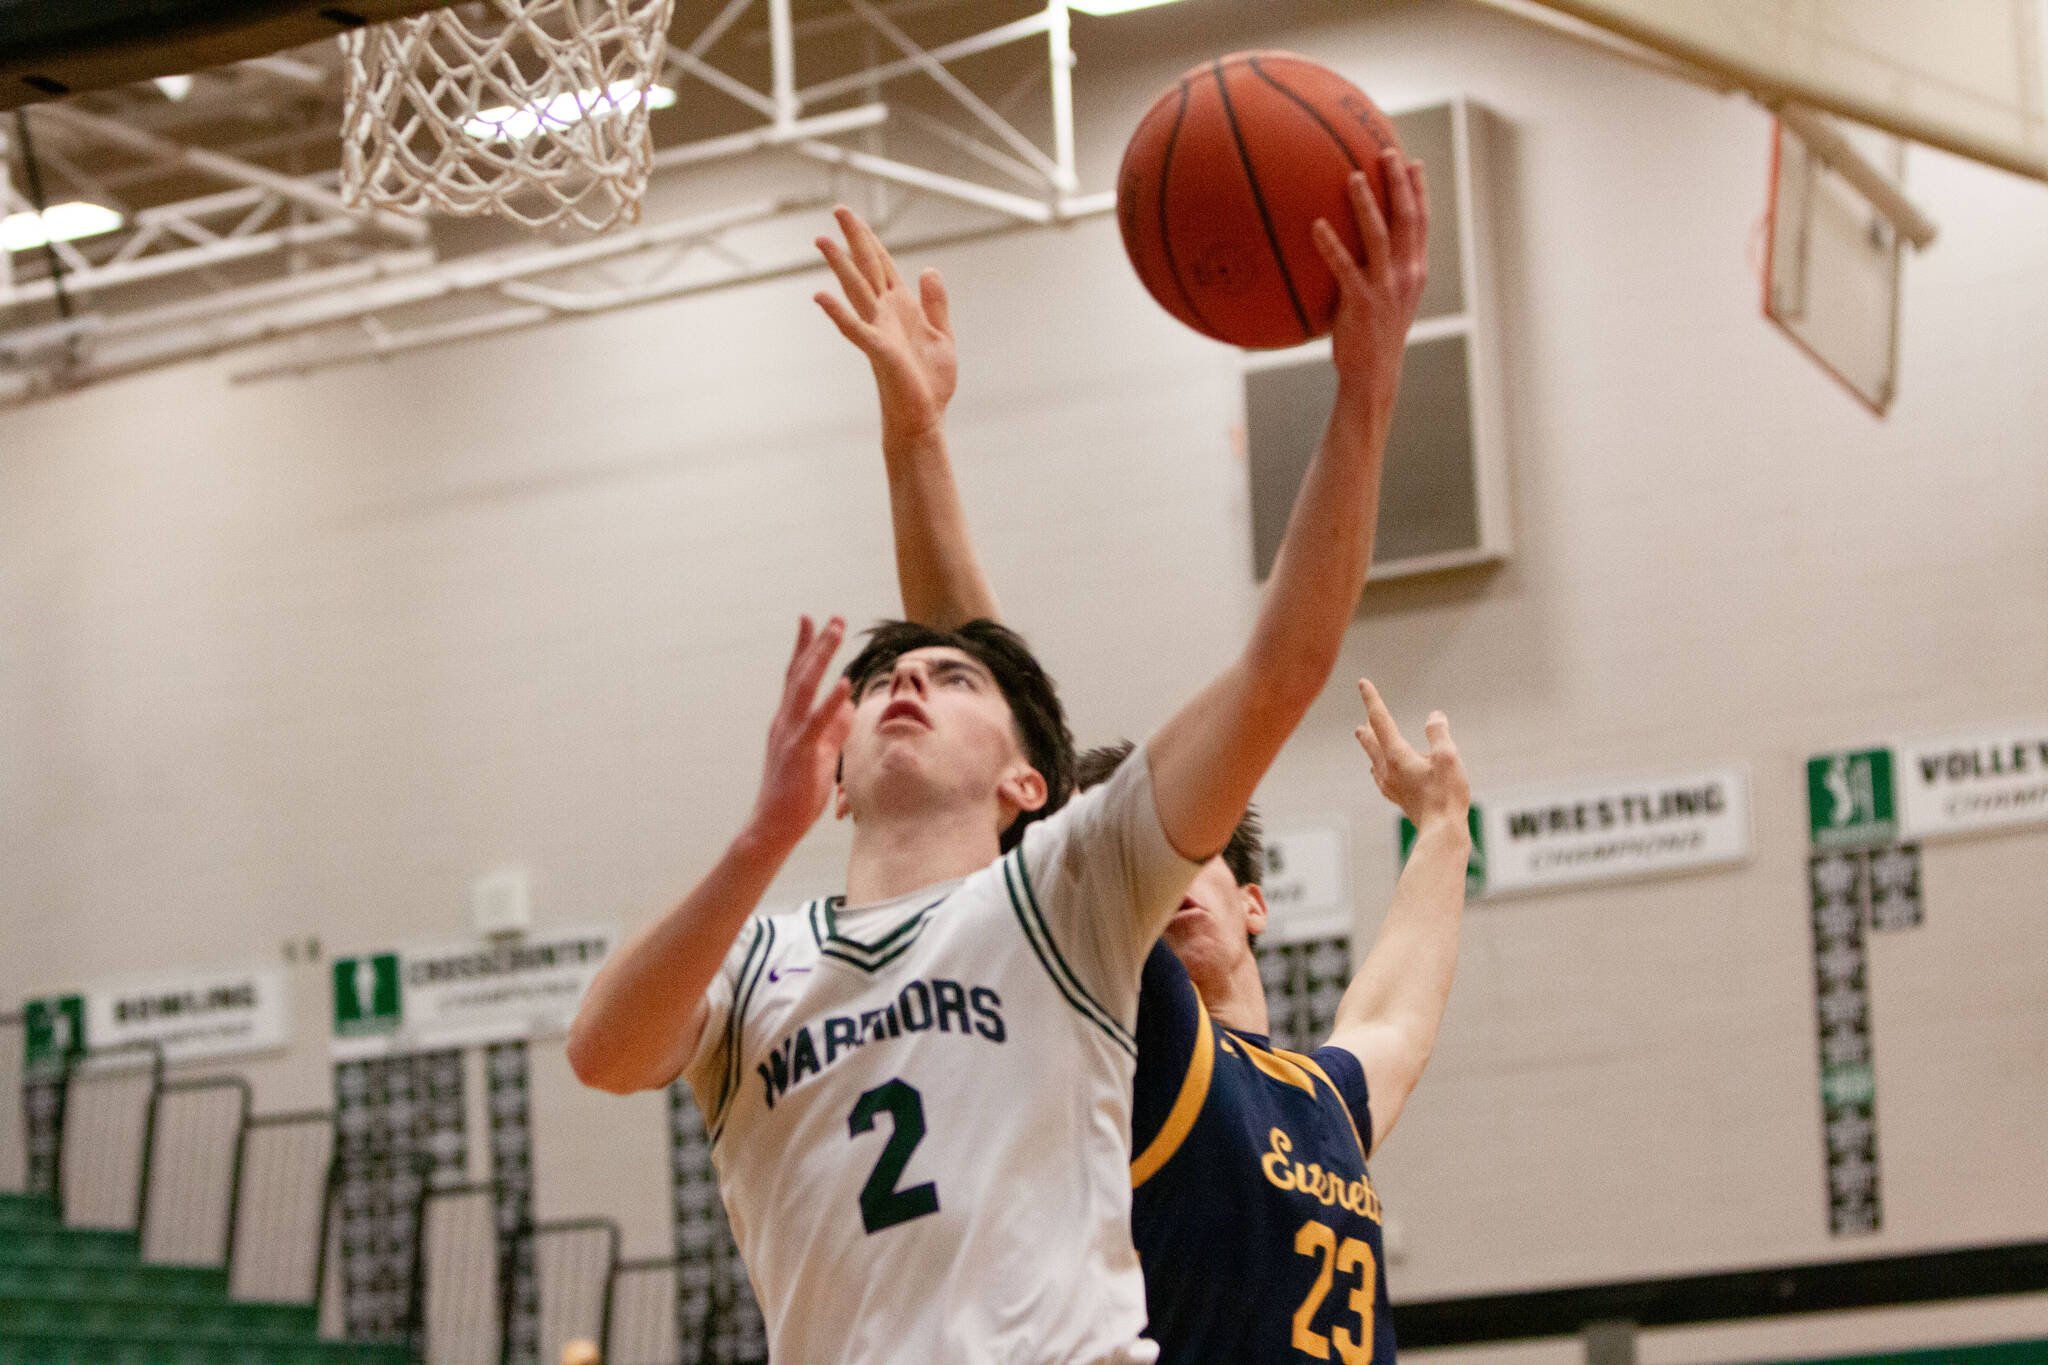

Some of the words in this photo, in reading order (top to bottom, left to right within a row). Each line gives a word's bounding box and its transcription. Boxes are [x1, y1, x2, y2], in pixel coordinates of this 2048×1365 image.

[1507, 780, 1726, 840] WRESTLING
[757, 978, 1007, 1111] WARRIORS
[847, 1077, 940, 1236] 2
[1291, 1219, 1377, 1365] 23
